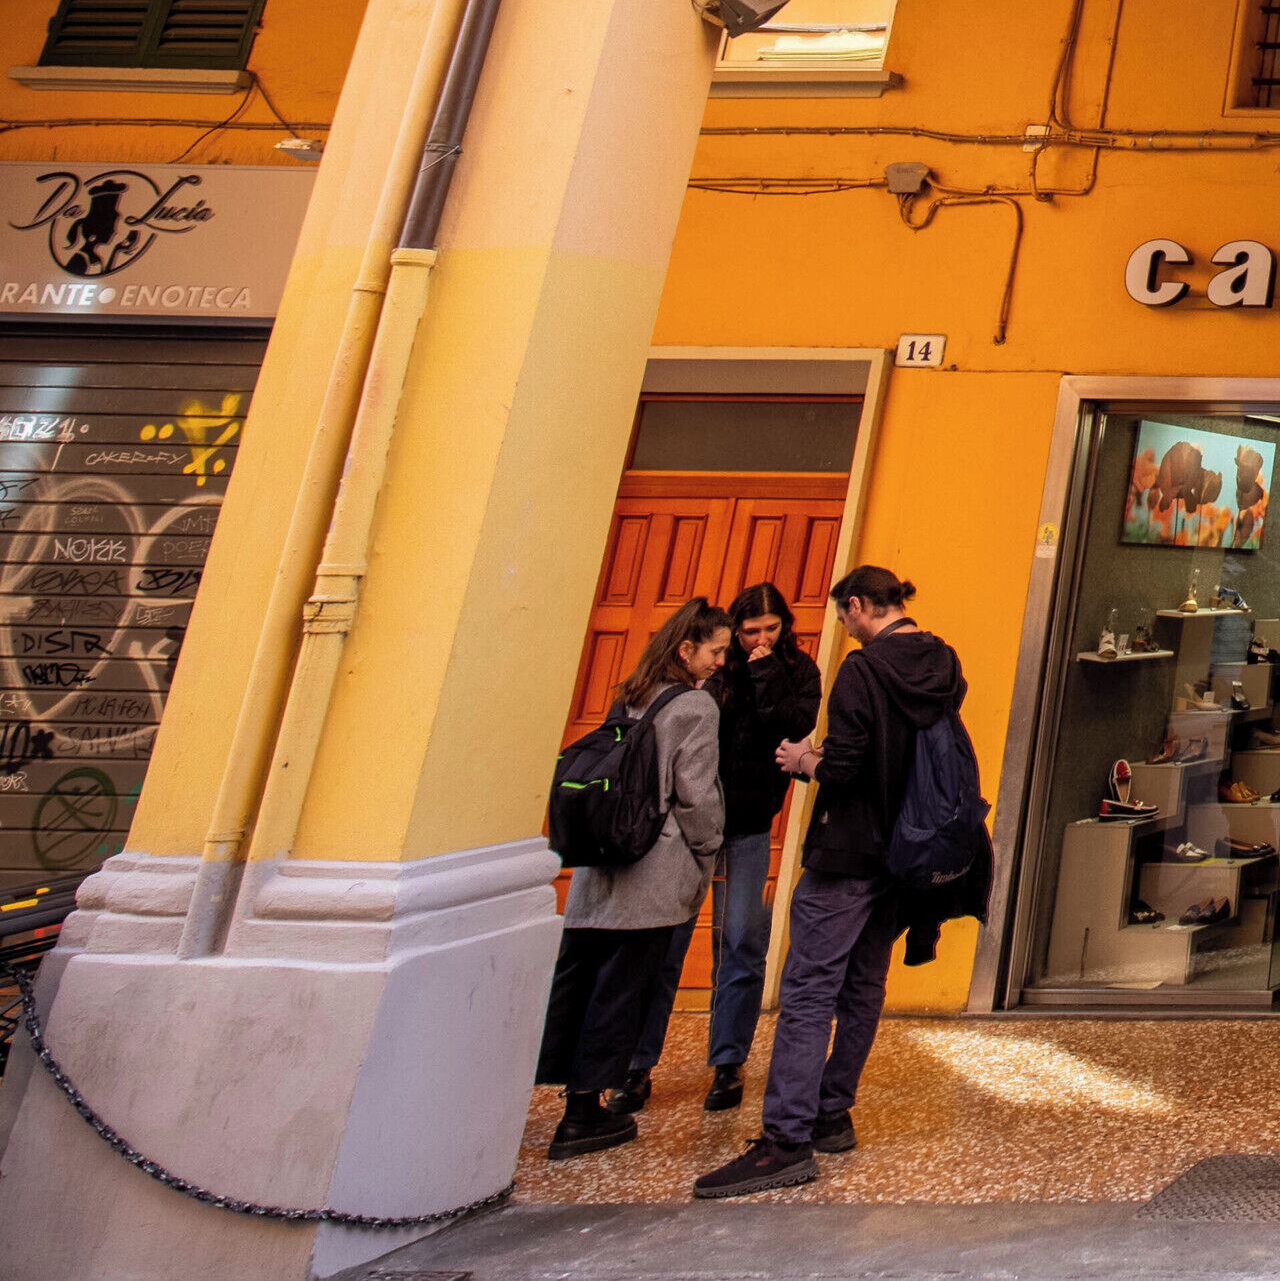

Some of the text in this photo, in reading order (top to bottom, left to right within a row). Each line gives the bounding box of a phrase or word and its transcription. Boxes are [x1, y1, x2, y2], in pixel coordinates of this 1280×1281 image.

[9, 171, 216, 233] Da Lucia
[0, 282, 251, 310] RANTE ENOTECA
[906, 340, 932, 361] 14
